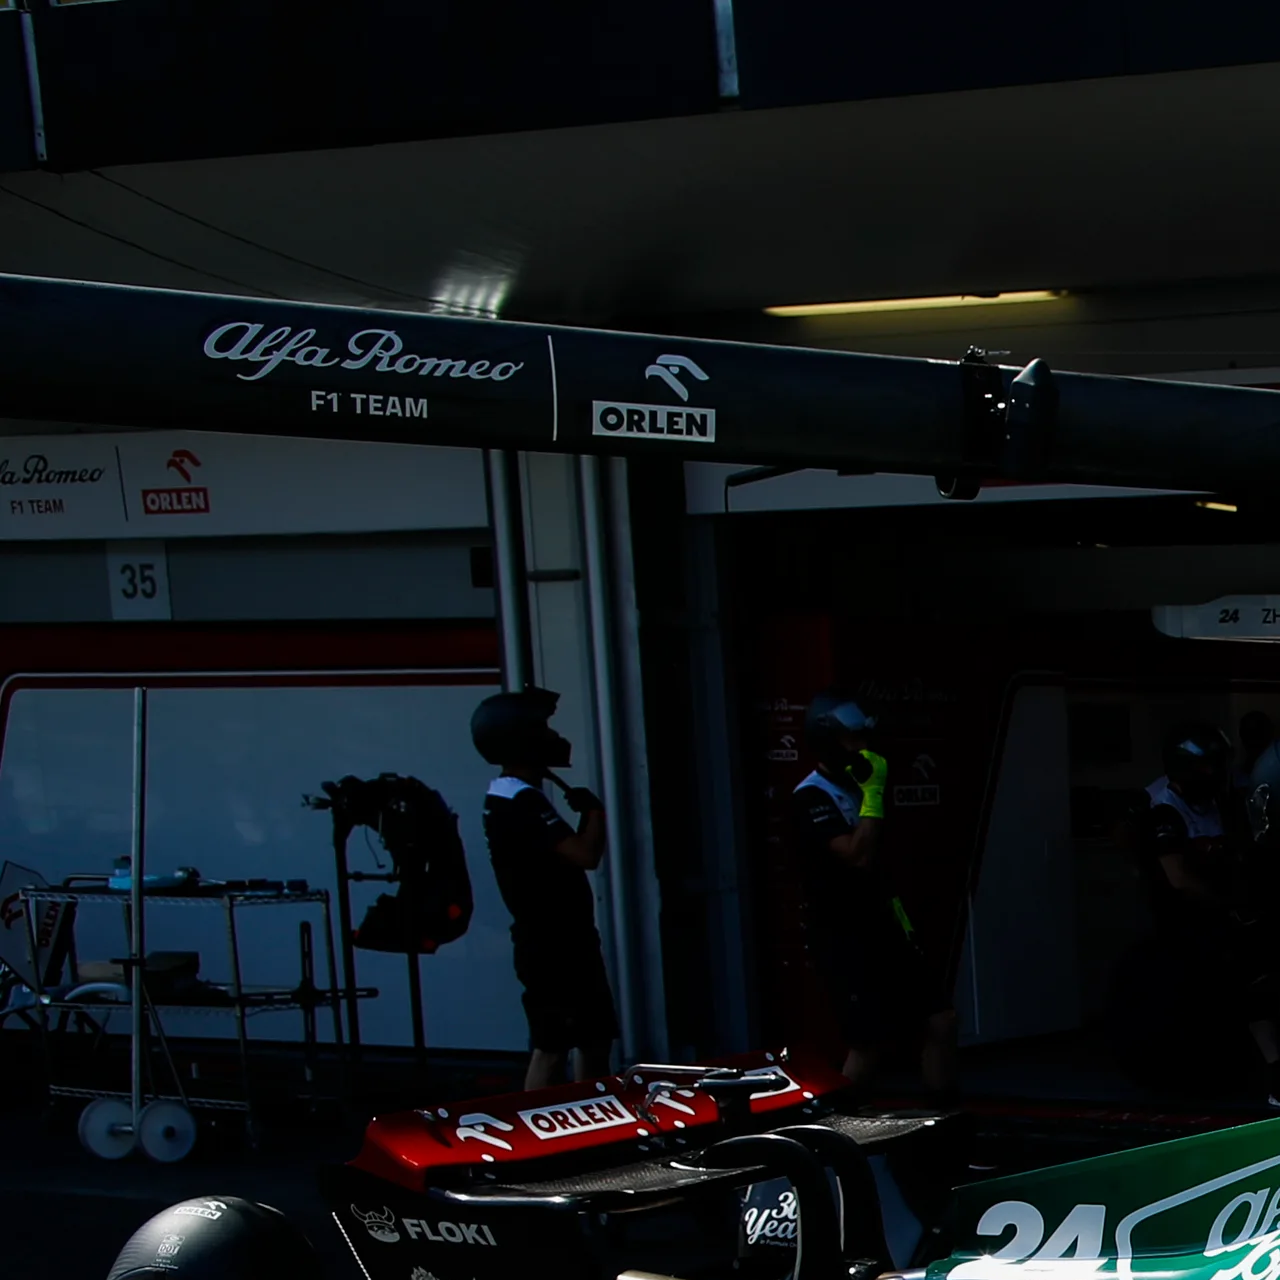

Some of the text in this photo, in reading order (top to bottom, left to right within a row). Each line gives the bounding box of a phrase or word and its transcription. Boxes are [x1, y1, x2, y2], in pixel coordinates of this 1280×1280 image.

[203, 321, 524, 382] Alfa Romeo
[310, 391, 429, 420] F1 TEAM
[599, 406, 709, 437] ORLEN
[22, 455, 105, 485] Romeo
[11, 499, 65, 514] F1 TEAM
[147, 492, 206, 511] ORLEN
[120, 563, 156, 599] 35
[1219, 609, 1239, 623] 24
[530, 1099, 625, 1137] ORLEN
[401, 1217, 498, 1248] FLOKI
